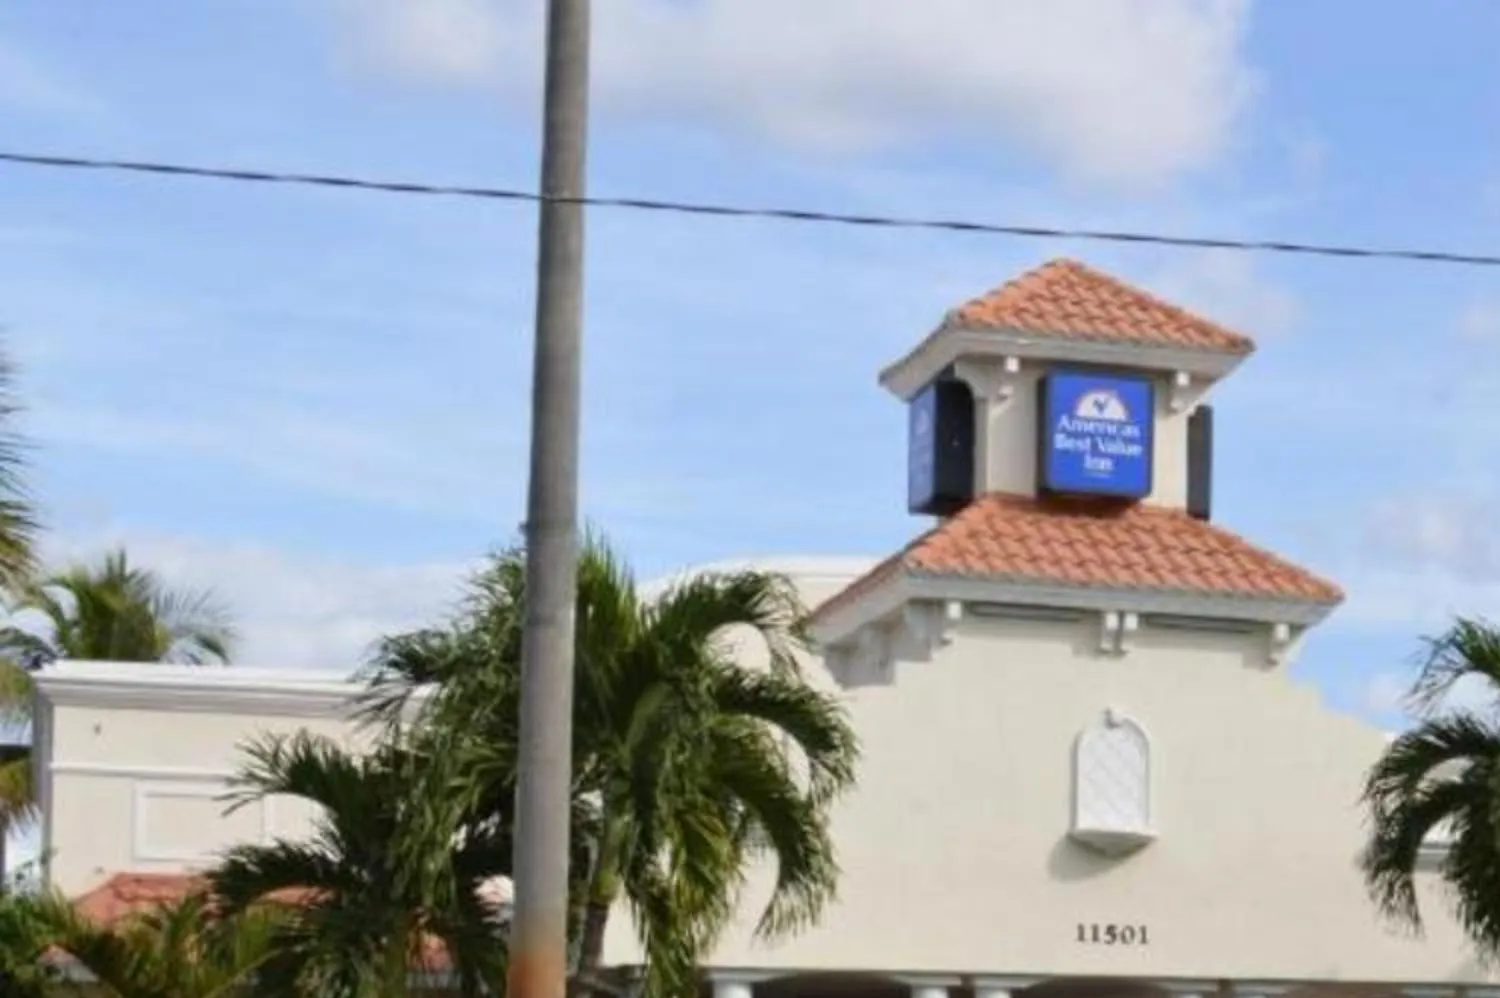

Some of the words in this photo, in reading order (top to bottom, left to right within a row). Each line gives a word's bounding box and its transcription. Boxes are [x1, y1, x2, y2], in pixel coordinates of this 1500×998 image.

[1057, 414, 1141, 437] Americas
[1054, 433, 1091, 452] Best
[1095, 436, 1143, 456] Value
[1083, 452, 1114, 471] Inn
[1076, 922, 1148, 945] 11501
